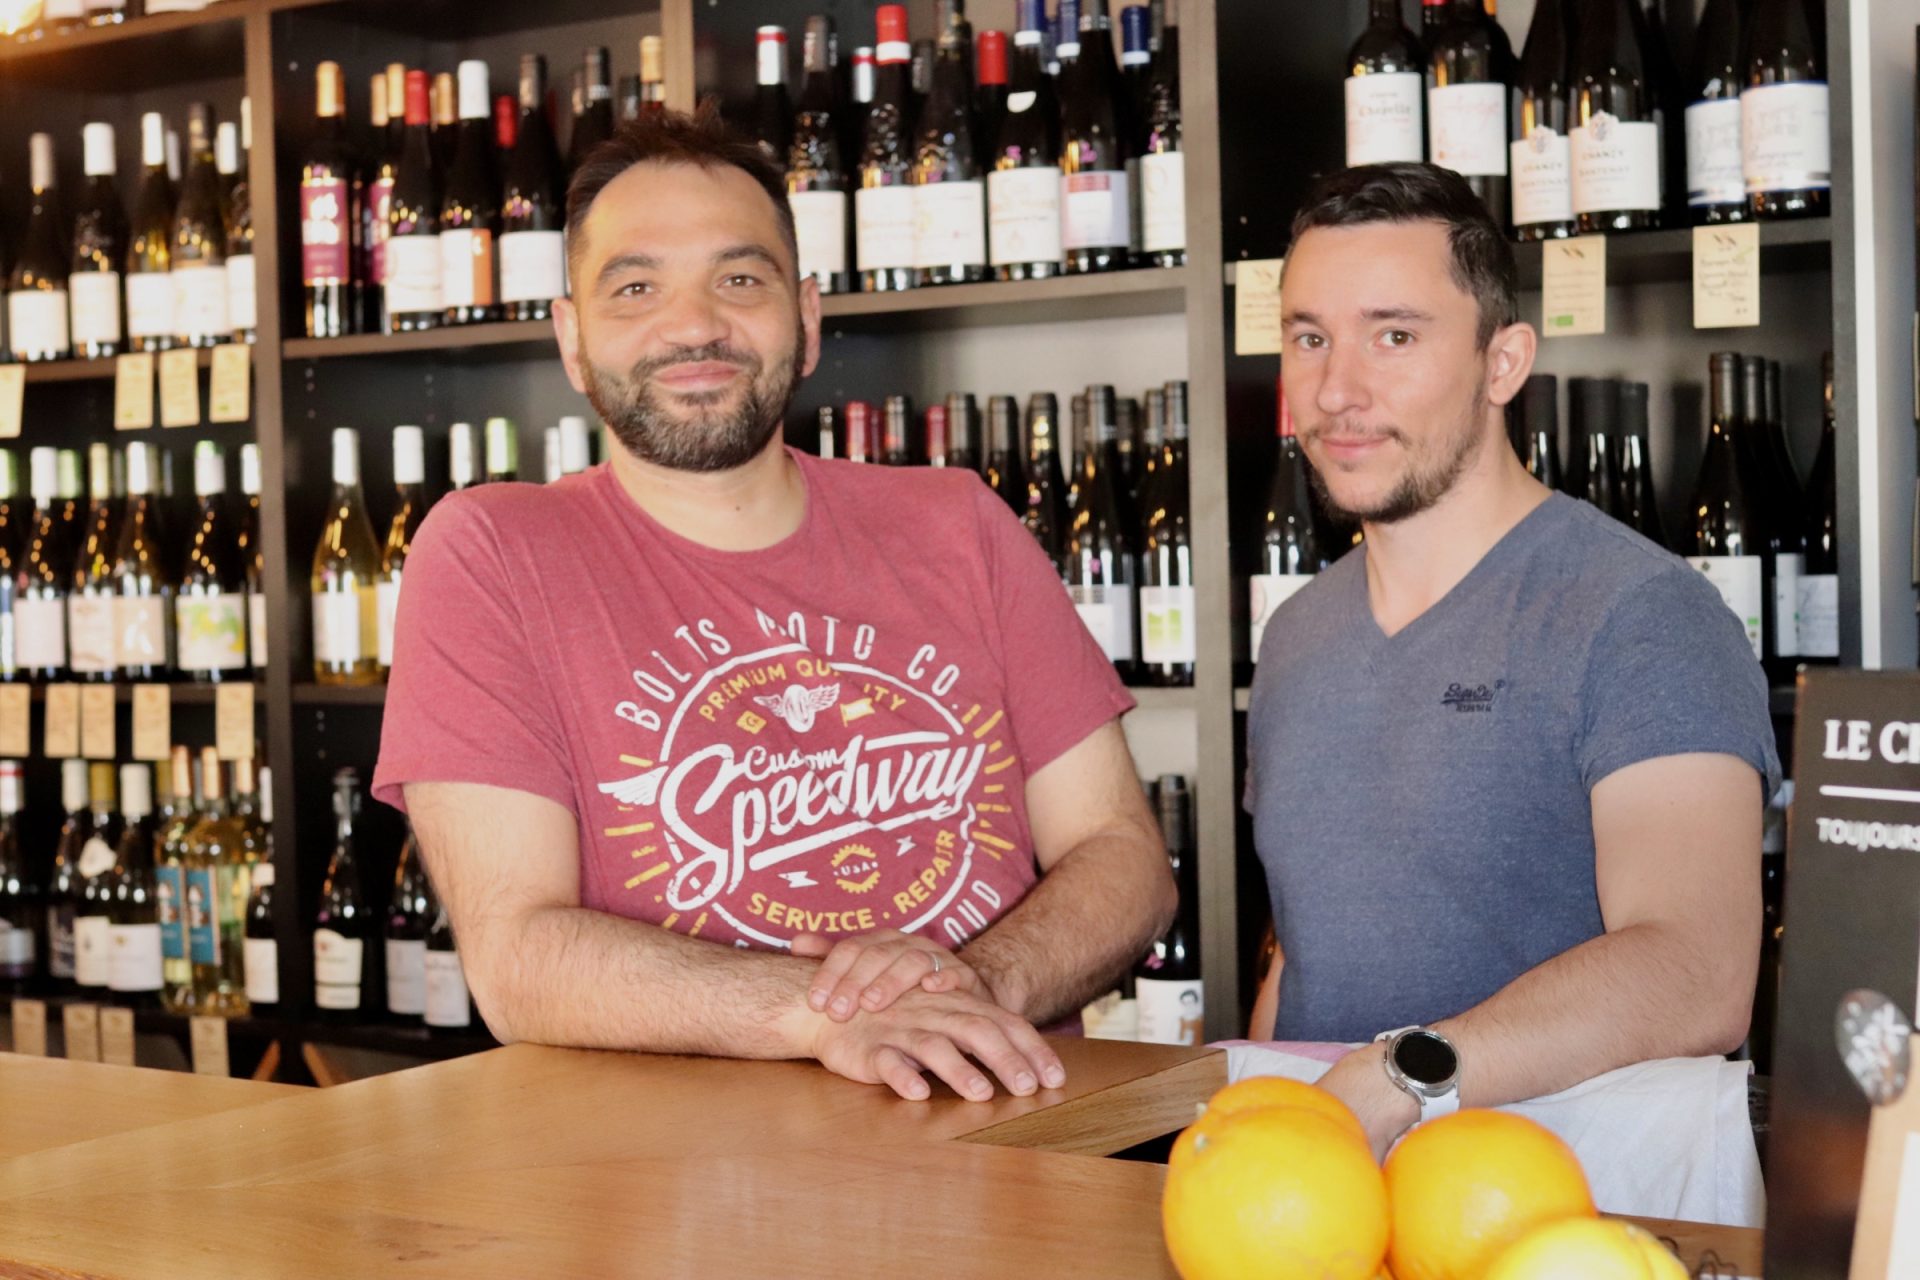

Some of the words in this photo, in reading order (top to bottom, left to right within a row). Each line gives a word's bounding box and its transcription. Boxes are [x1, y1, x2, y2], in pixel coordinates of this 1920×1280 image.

[614, 618, 732, 732] BOLTS
[906, 644, 960, 710] CO.
[699, 662, 787, 722] PREMIUM
[1822, 718, 1872, 761] LE
[659, 734, 987, 911] Speedway
[746, 892, 876, 933] SERVICE
[892, 829, 957, 914] REPAIR
